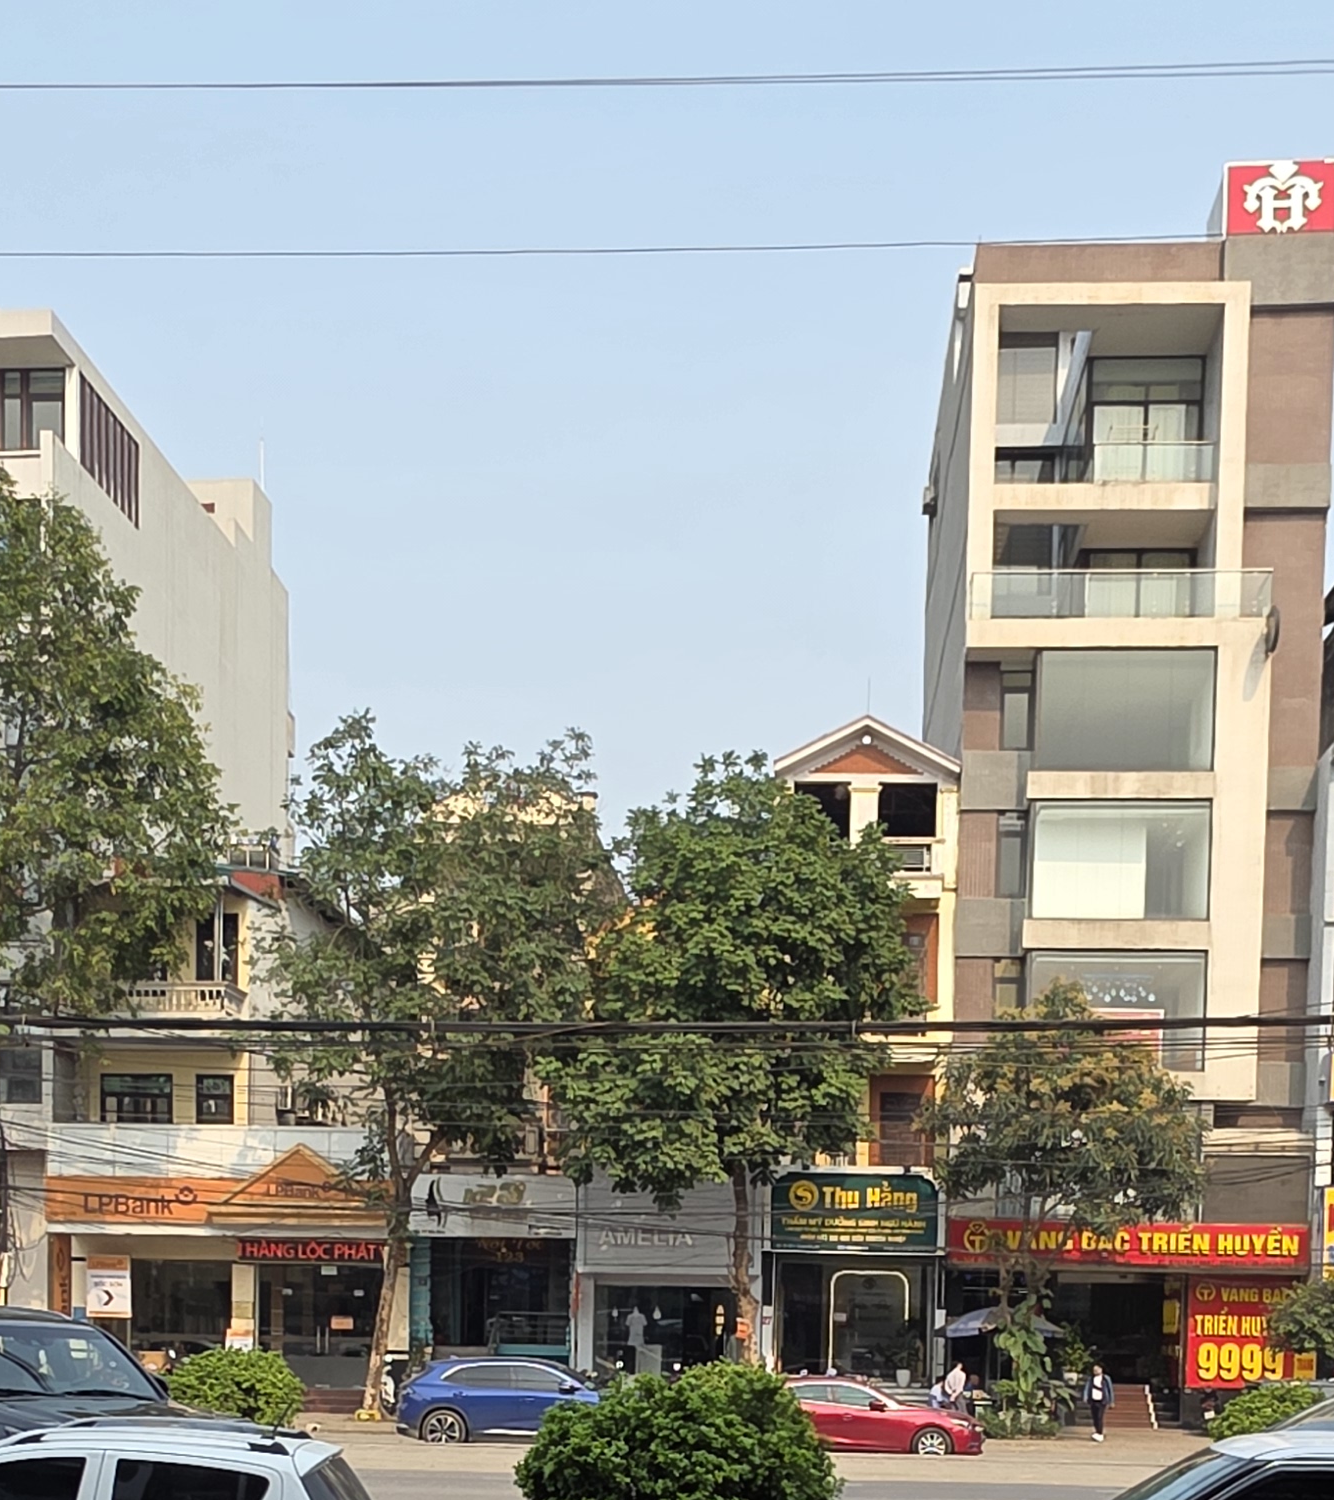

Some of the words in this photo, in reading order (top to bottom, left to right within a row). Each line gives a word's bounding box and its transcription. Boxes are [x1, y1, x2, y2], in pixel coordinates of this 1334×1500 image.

[83, 1192, 174, 1216] LPBank
[822, 1186, 860, 1210] Thu
[865, 1180, 918, 1213] Hằng
[246, 1239, 295, 1259] HÀNG
[298, 1240, 331, 1262] LỘC
[334, 1239, 377, 1260] PHÁT
[599, 1227, 693, 1247] AMELIA
[1138, 1222, 1211, 1256] TRIỂN
[1217, 1226, 1300, 1257] HUYỀN
[1194, 1306, 1239, 1336] TRIỂN
[1197, 1342, 1286, 1381] 9999
